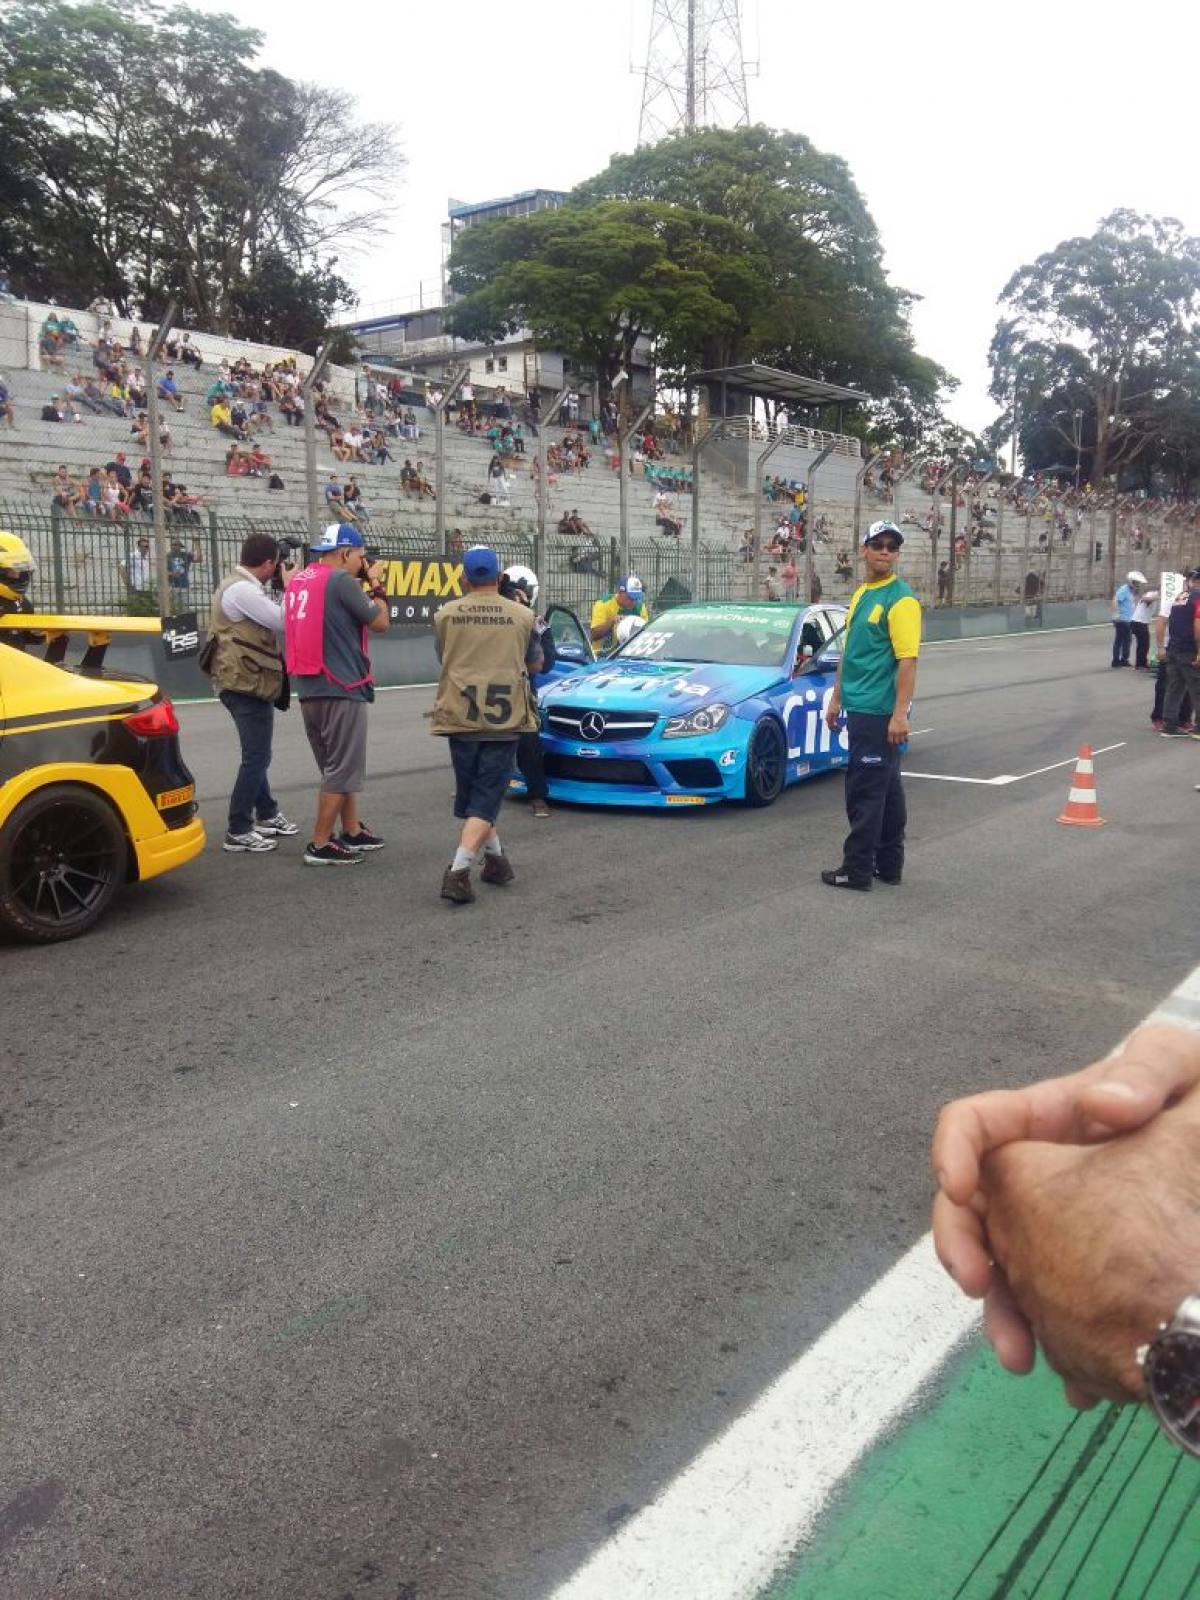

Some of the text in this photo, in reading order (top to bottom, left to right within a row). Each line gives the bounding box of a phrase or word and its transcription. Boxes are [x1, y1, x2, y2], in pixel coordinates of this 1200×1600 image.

[457, 603, 503, 613] Canon
[452, 615, 516, 626] IMPRENSA
[460, 683, 513, 725] 15
